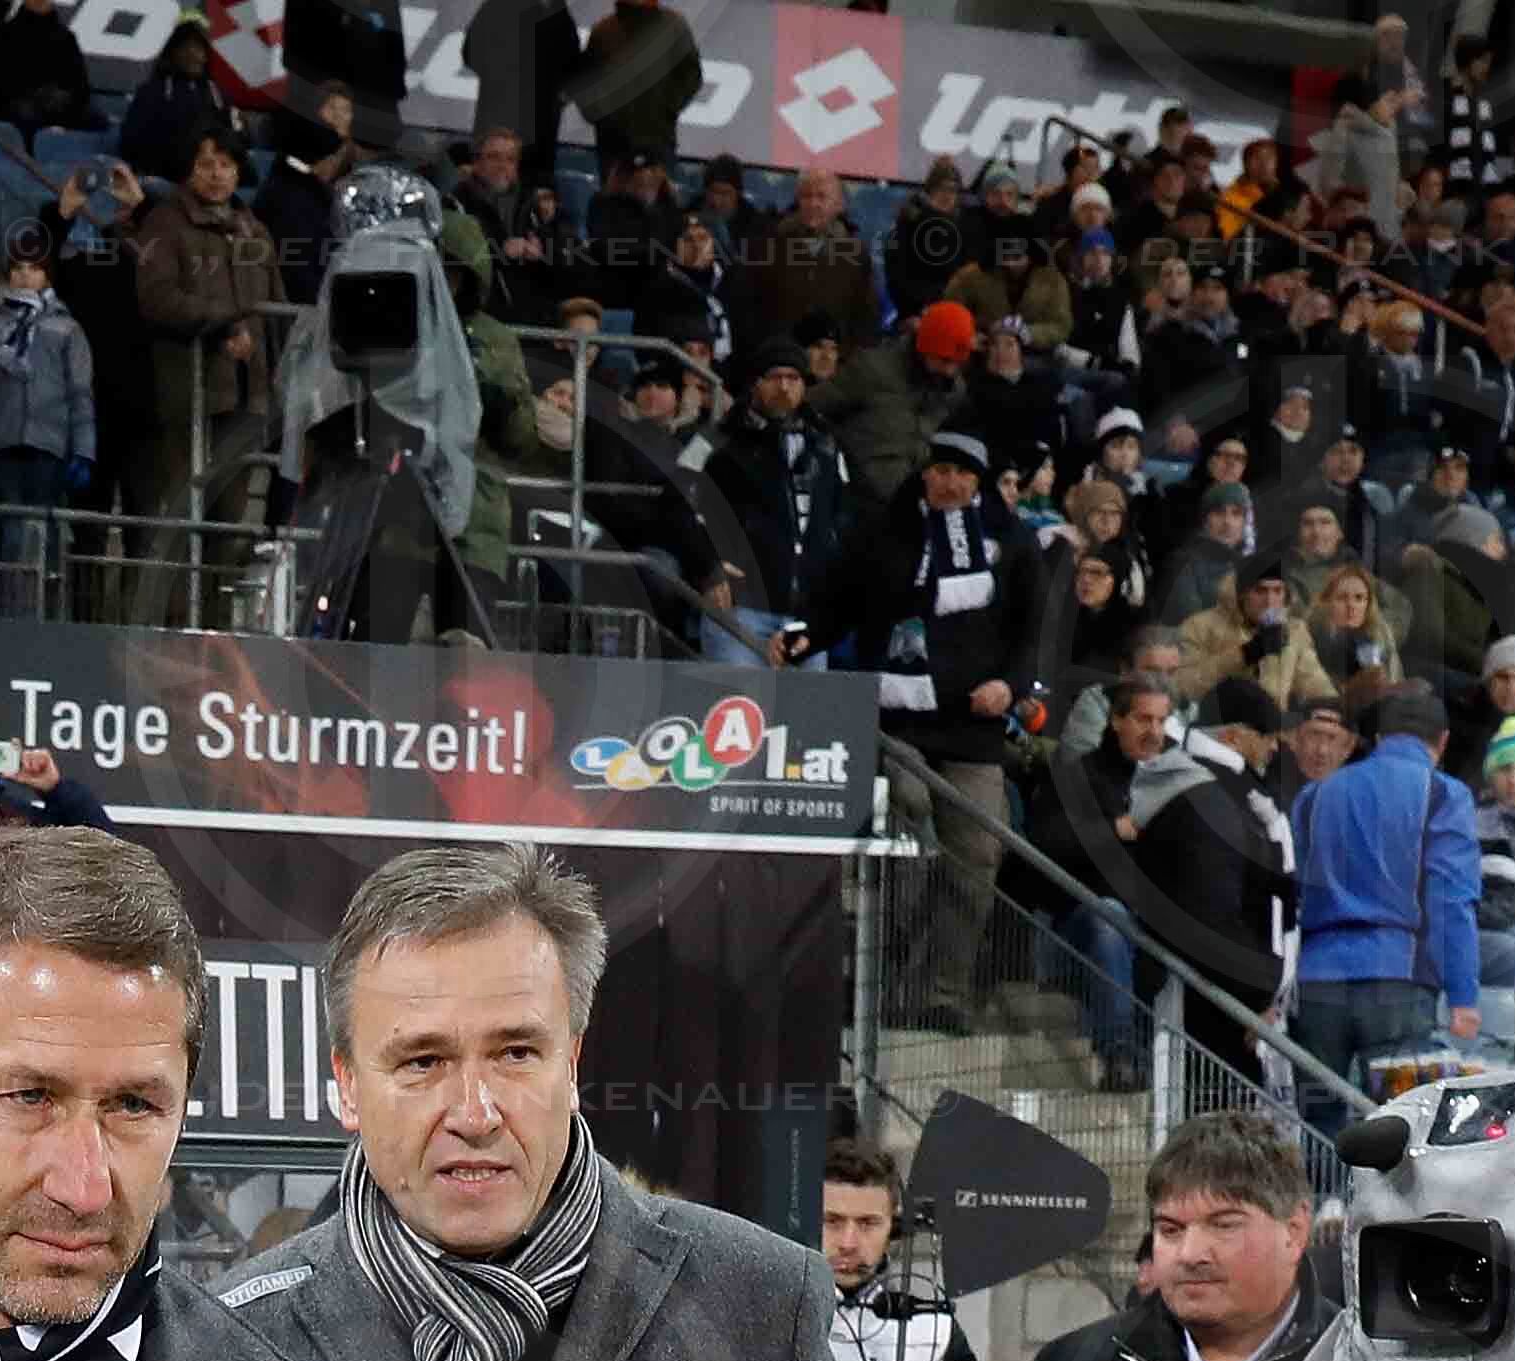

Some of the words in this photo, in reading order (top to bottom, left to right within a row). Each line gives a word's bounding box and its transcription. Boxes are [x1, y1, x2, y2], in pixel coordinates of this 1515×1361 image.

[11, 680, 168, 770] Tage
[197, 691, 526, 775] Sturmzeit!
[710, 796, 759, 815] SPIRIT
[786, 801, 845, 819] SPORTS
